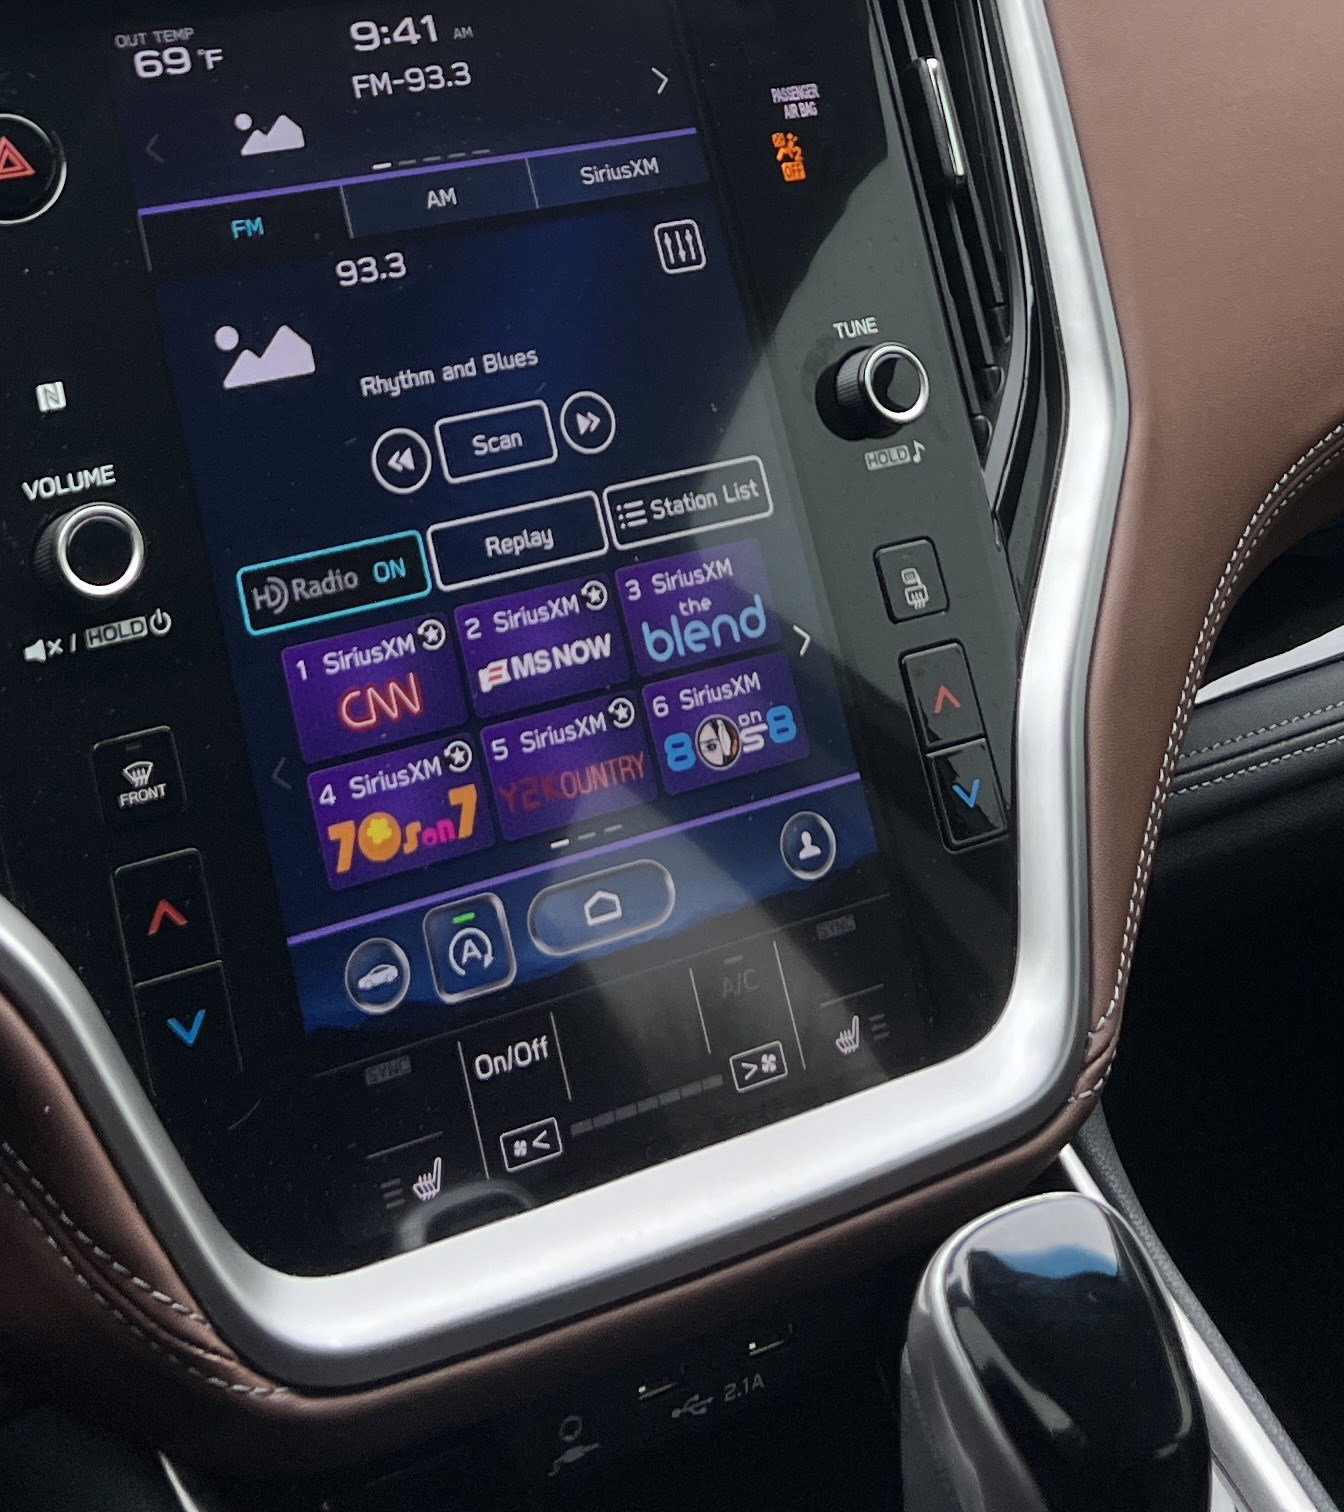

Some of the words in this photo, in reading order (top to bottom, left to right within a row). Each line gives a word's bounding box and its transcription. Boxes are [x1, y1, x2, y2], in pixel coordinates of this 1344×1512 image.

[113, 32, 148, 49] OUT
[152, 27, 195, 44] TEMP
[349, 14, 438, 52] 9:41
[453, 25, 474, 39] AM
[133, 46, 192, 79] 69
[351, 61, 472, 99] FM-93.3
[579, 157, 660, 185] SiriusXM
[426, 187, 457, 211] AM
[230, 217, 265, 240] FM
[335, 252, 408, 287] 93.3
[832, 316, 879, 339] TUNE
[359, 368, 436, 398] Rhythm
[442, 357, 477, 382] and
[482, 349, 539, 374] Blues
[471, 432, 524, 457] Scan
[866, 447, 909, 469] HOLD
[22, 464, 117, 502] VOLUME
[649, 490, 719, 520] Station
[722, 479, 760, 503] List
[485, 527, 555, 557] Replay
[291, 568, 359, 601] Radio
[372, 557, 407, 584] ON
[624, 578, 643, 601] 3
[651, 557, 734, 595] SiriusXM
[464, 618, 482, 640] 2
[493, 594, 581, 634] SiriusXM
[678, 597, 713, 617] the
[86, 617, 147, 648] HOLD
[641, 593, 767, 662] blend
[296, 659, 308, 681] 1
[322, 633, 416, 676] SiriusXM
[340, 672, 423, 729] CNN
[652, 695, 669, 718] 6
[678, 671, 761, 711] SiriusXM
[491, 737, 509, 761] 5
[519, 711, 607, 754] SiriusXM
[117, 782, 167, 808] FRONT
[319, 783, 337, 806] 4
[349, 755, 443, 800] SiriusXM
[498, 750, 645, 813] Y2KOUNTRY
[474, 1035, 549, 1081] On/Off
[723, 1372, 765, 1402] 2.1A
